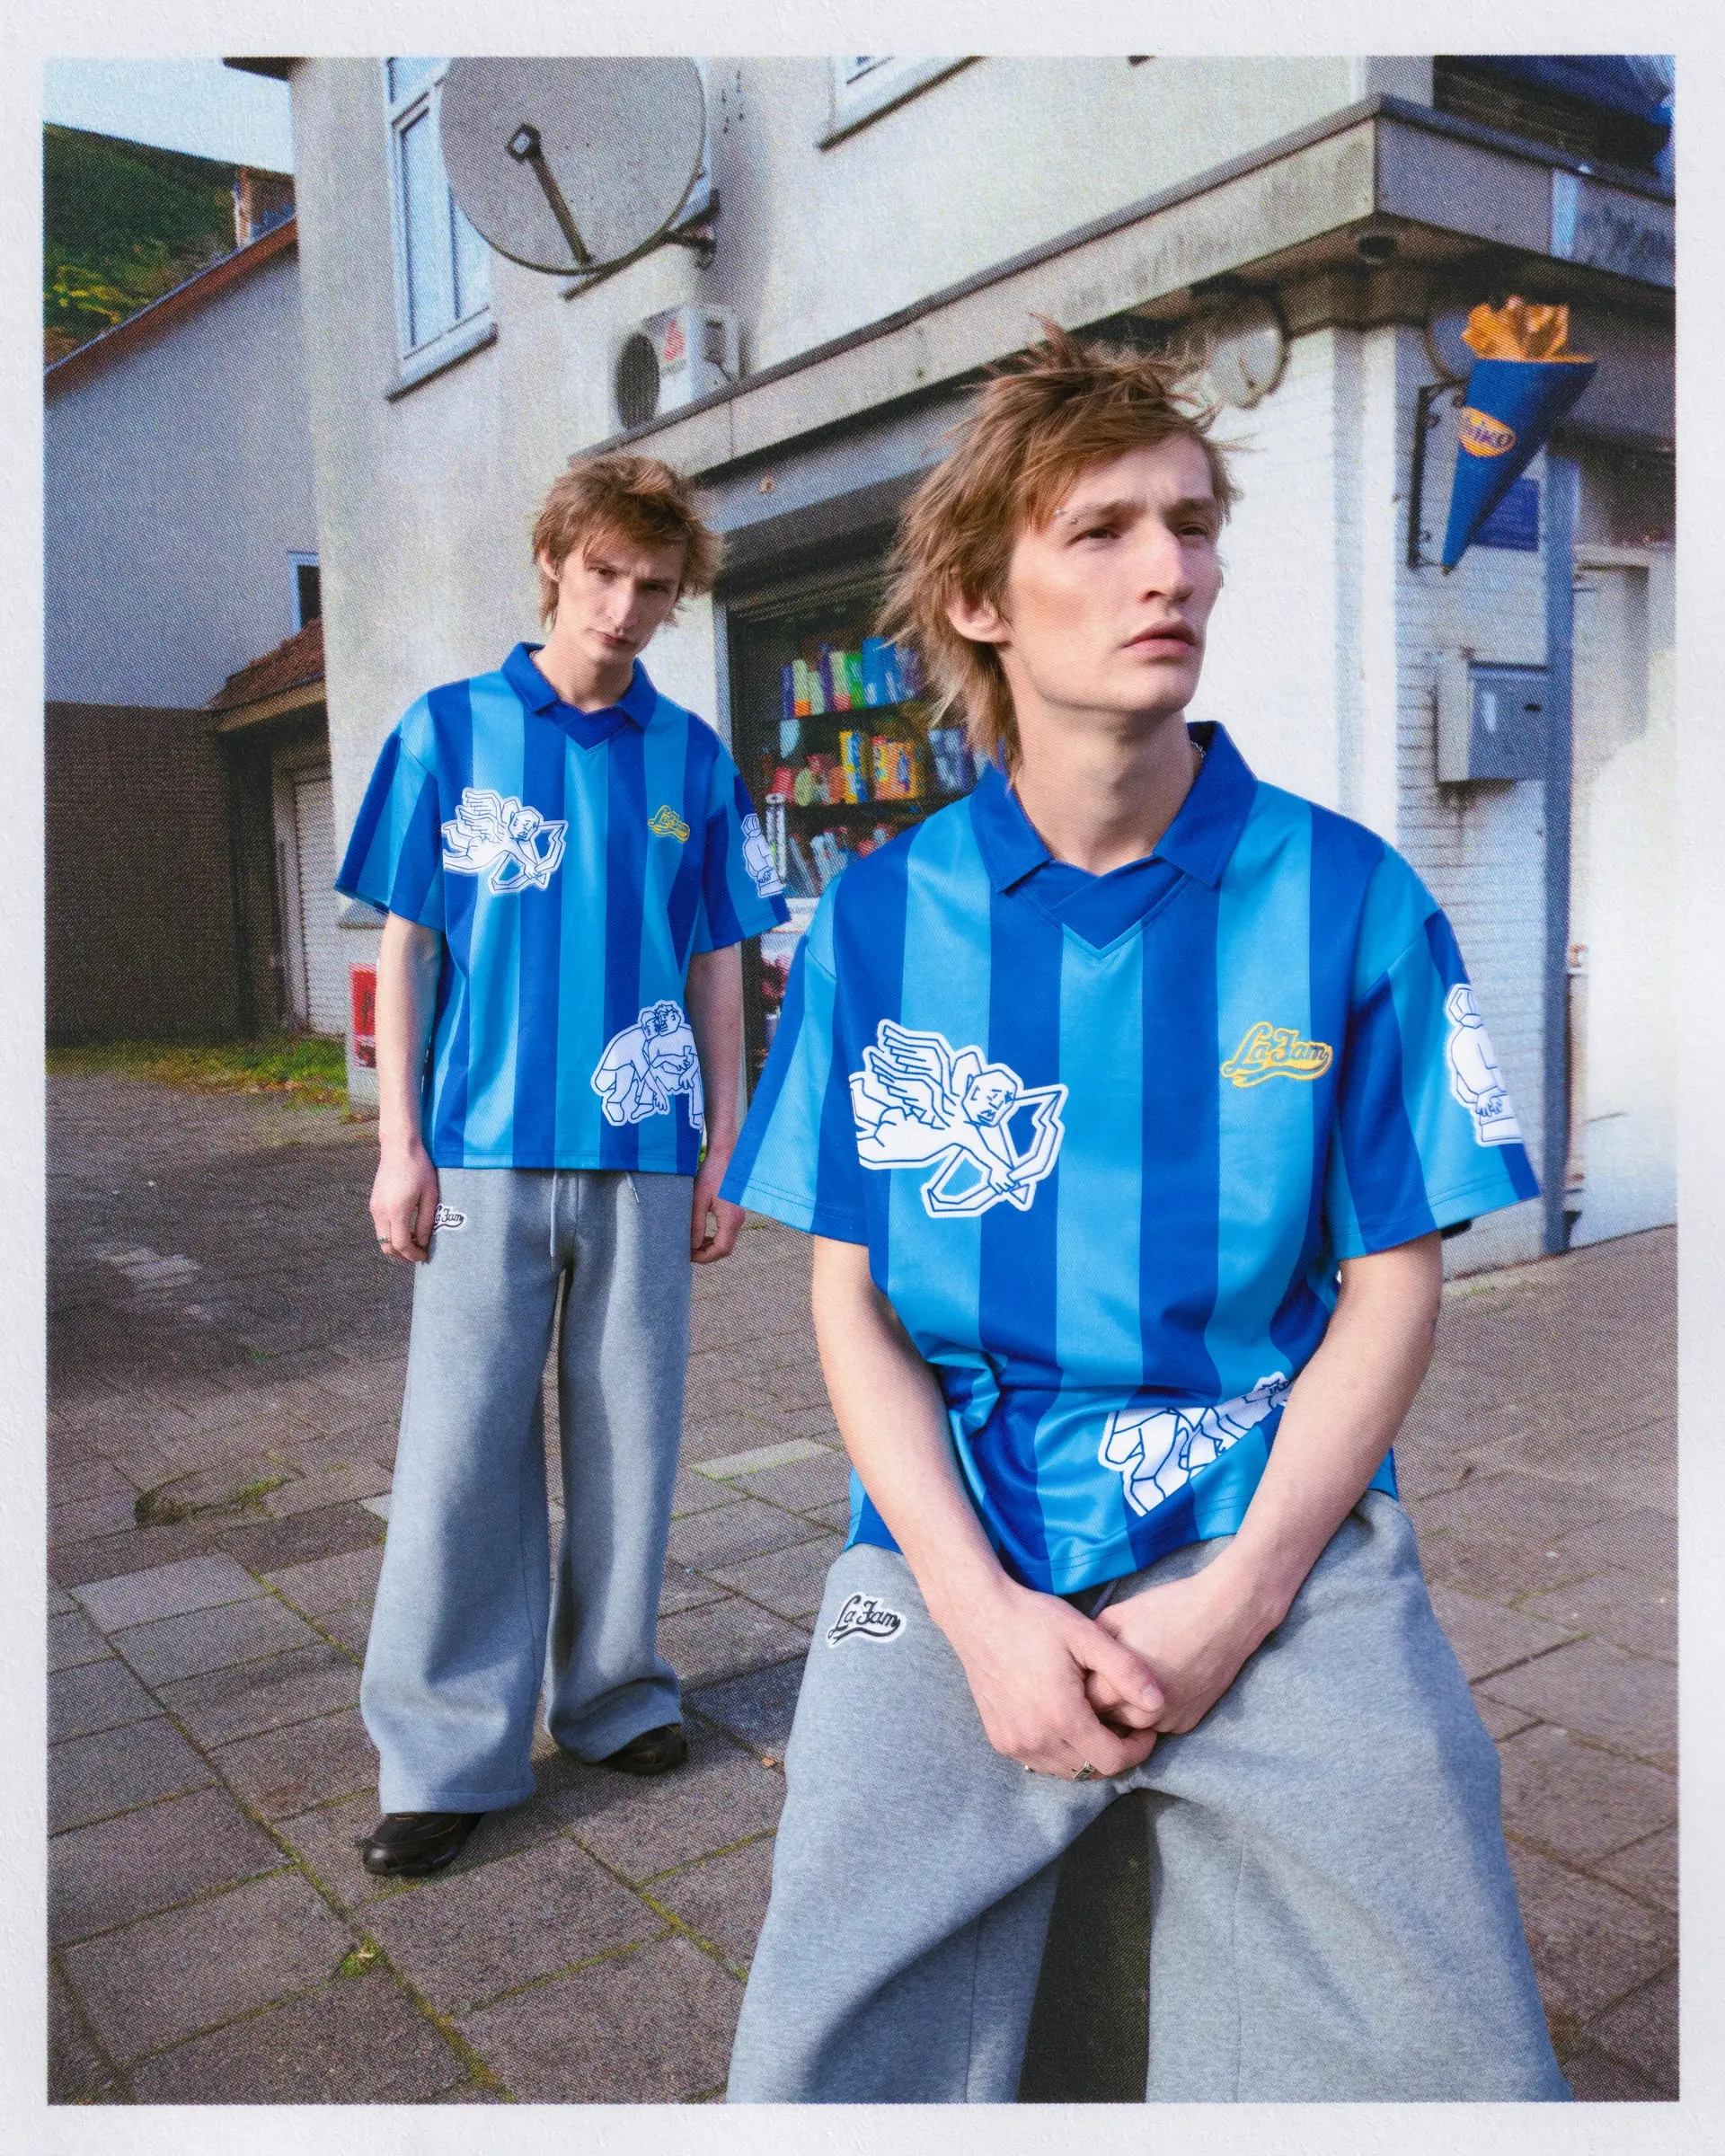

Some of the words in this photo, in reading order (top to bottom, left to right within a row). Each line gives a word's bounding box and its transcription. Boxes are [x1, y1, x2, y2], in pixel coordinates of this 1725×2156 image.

[1220, 1021, 1273, 1077] La
[827, 1595, 862, 1639] La
[856, 1600, 901, 1629] Fam
